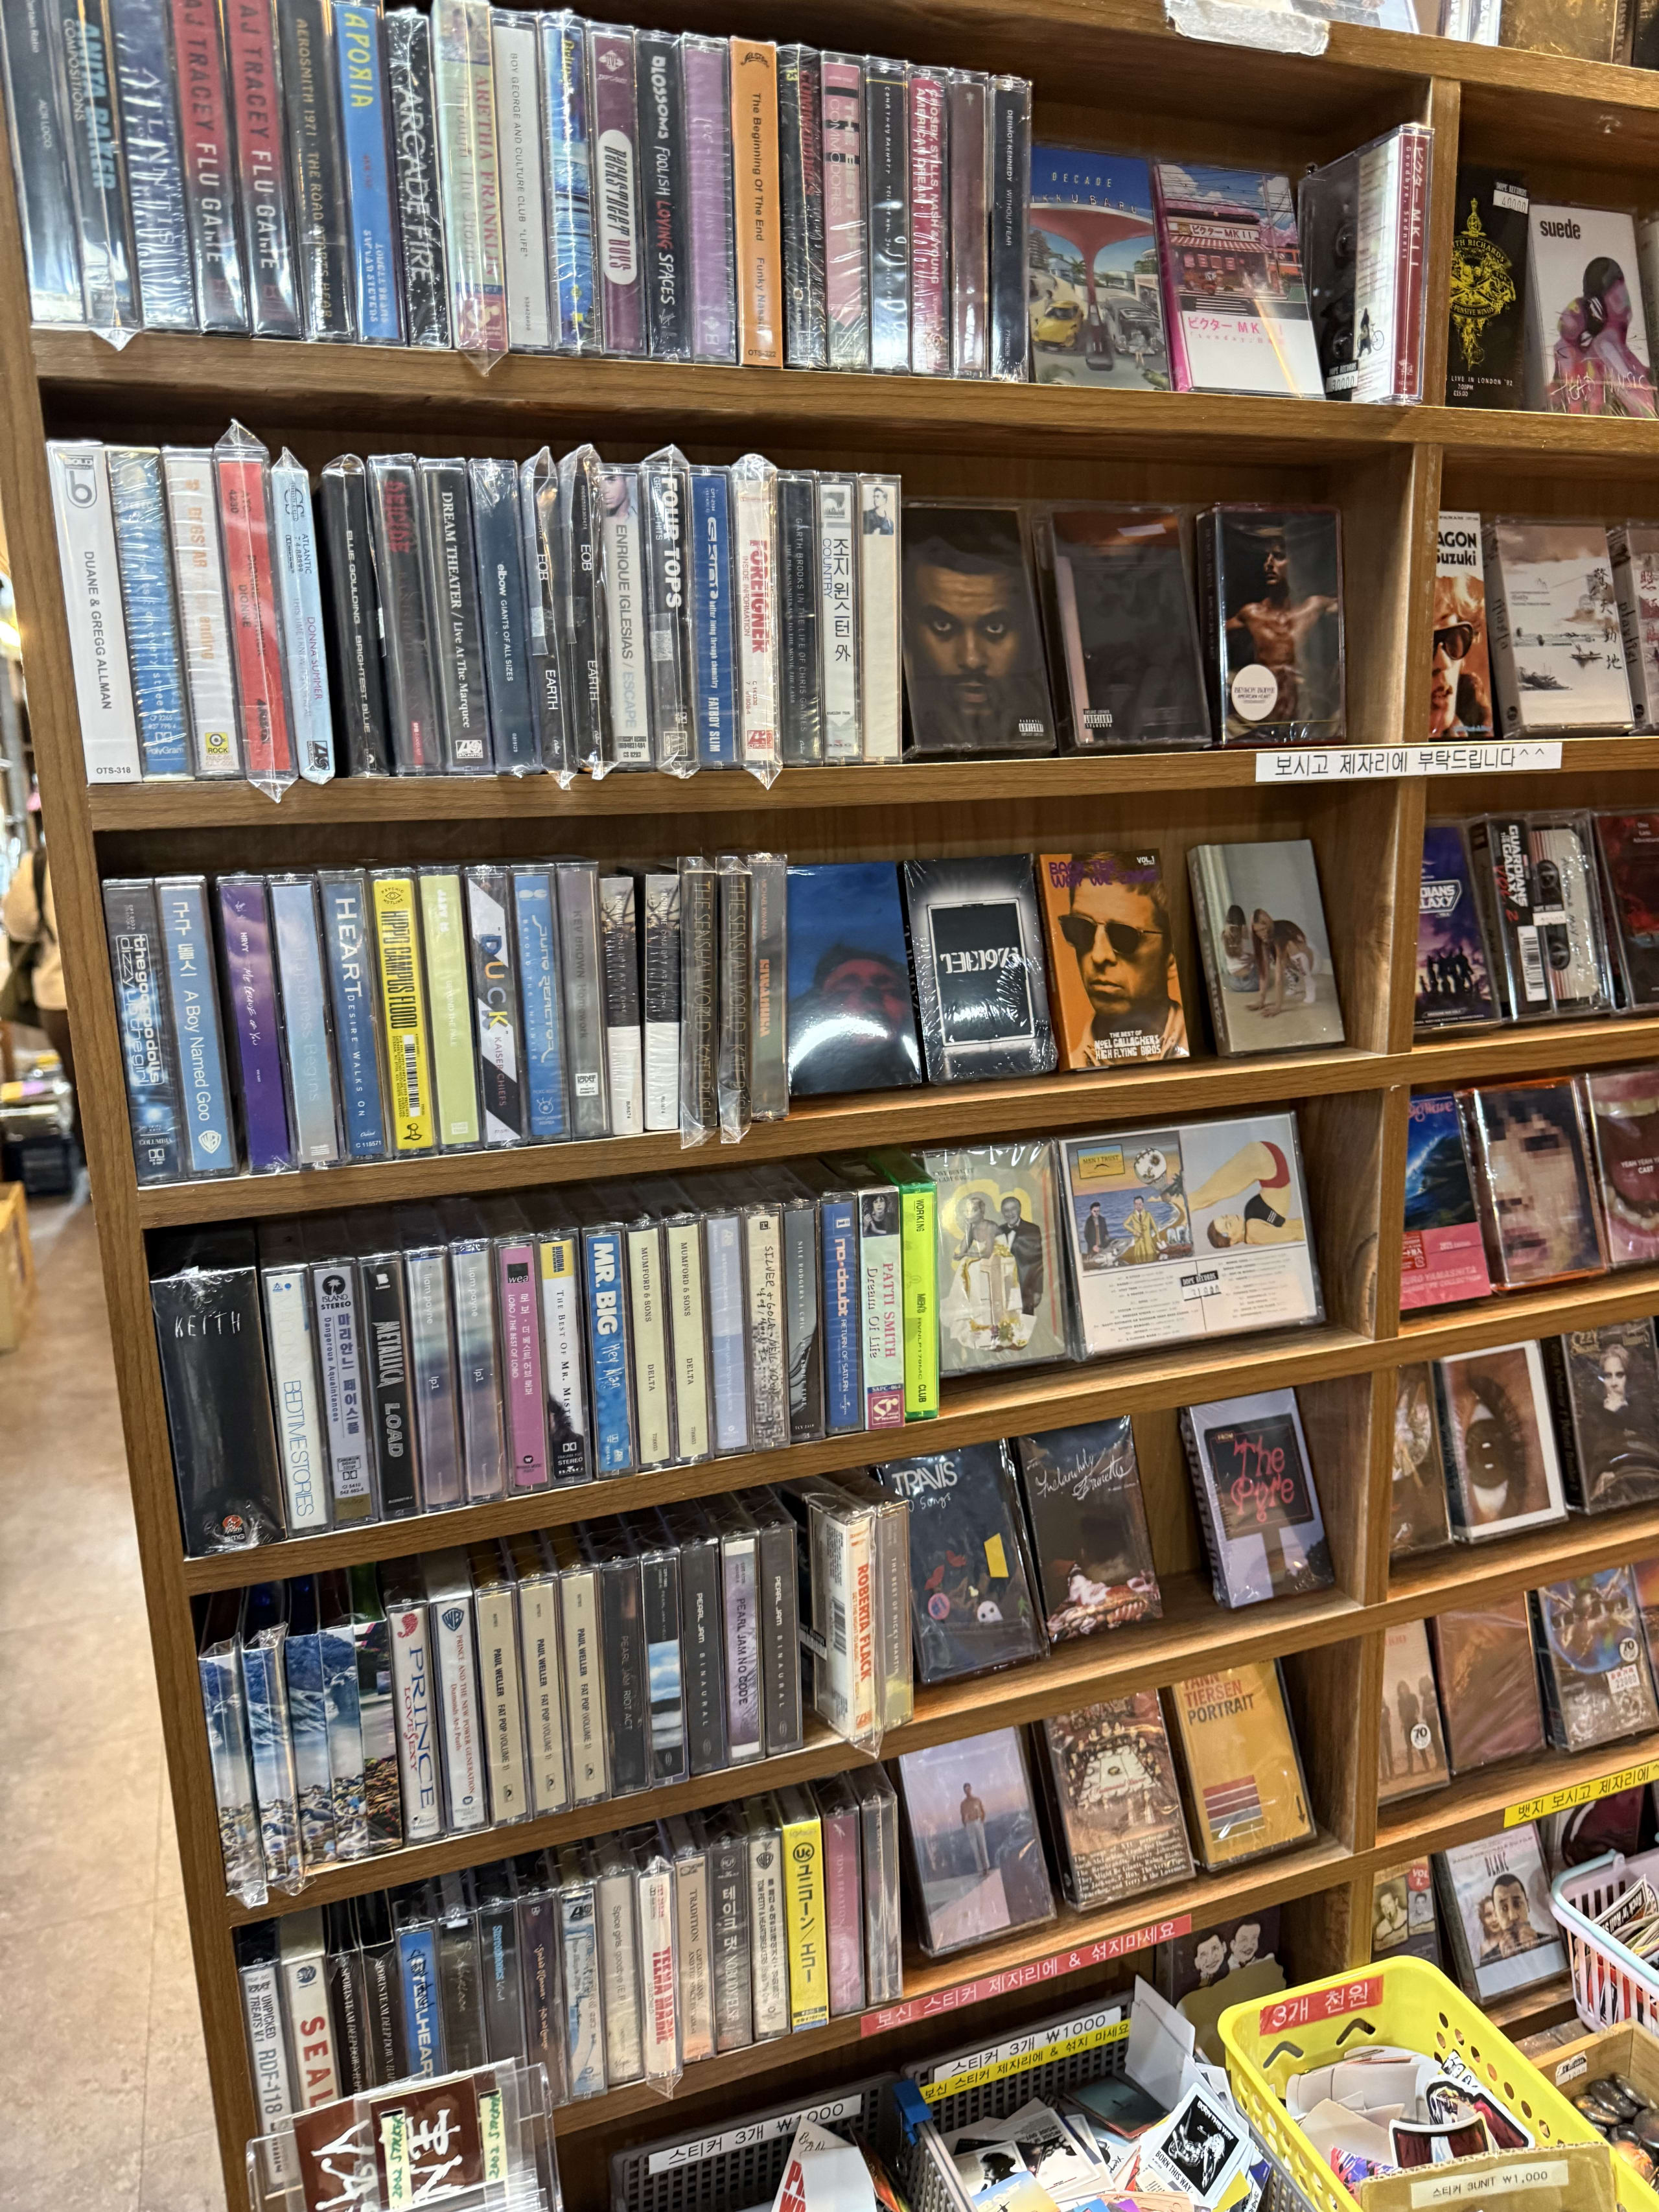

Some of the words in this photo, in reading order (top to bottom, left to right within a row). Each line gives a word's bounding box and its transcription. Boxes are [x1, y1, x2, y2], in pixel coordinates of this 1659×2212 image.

[240, 5, 261, 32] AJ
[510, 53, 518, 73] BOY
[244, 47, 271, 140] TRACEY
[511, 76, 520, 119] GEORGE
[651, 56, 669, 139] BLOSSOMS
[752, 93, 762, 113] The
[398, 87, 430, 215] ARCADE
[513, 122, 522, 144] AND
[752, 117, 762, 175] Beginning
[250, 150, 275, 194] FLU
[515, 147, 525, 192] CULTURE
[654, 146, 671, 196] FOOLISH
[754, 178, 763, 192] Of
[1051, 171, 1114, 188] DECADE
[517, 196, 527, 222] CLUB
[656, 201, 673, 249] LOVING
[754, 196, 763, 216] The
[255, 204, 279, 270] GAME
[519, 229, 528, 257] "LIFE"
[755, 219, 764, 241] End
[1540, 219, 1581, 239] suede
[405, 224, 434, 281] FIRE
[609, 239, 631, 270] BOYS
[657, 252, 675, 305] SPACES
[441, 492, 456, 541] DREAM
[661, 477, 679, 541] FOUR
[346, 531, 355, 560] ELLIE
[616, 524, 629, 590] ENRIQUE
[833, 539, 850, 576] 조지
[84, 552, 99, 595] DUANE
[446, 546, 461, 609] THEATER
[498, 564, 507, 596] elbow
[664, 547, 682, 608] TOPS
[822, 539, 833, 598] COUNTRY
[349, 564, 360, 623] GOULDING
[834, 583, 850, 638] 윈스턴
[91, 611, 106, 655] GREGG
[454, 622, 463, 643] Live
[500, 600, 509, 629] GIANTS
[619, 595, 633, 659] IGLESIAS
[307, 616, 318, 657] DONNA
[457, 647, 465, 658] At
[504, 631, 511, 643] OF
[97, 659, 111, 710] ALLMAN
[311, 660, 323, 699] SUMMER
[355, 636, 367, 699] BRIGHTEST
[458, 660, 467, 680] The
[505, 660, 513, 681] SIZES
[362, 704, 370, 733] BLUE
[458, 683, 471, 728] Marquee
[622, 671, 636, 728] ESCAPE
[708, 697, 719, 728] FATBOY
[709, 731, 720, 752] SLIM
[1275, 753, 1329, 776] 보시고
[1340, 750, 1408, 774] 제자리에
[172, 902, 192, 935] 구구
[380, 910, 410, 944] HIPPO
[178, 944, 197, 977] 돌스
[240, 933, 249, 952] HRVY
[336, 898, 362, 997] HEART
[384, 947, 415, 994] CAMPUS
[184, 990, 199, 1002] A
[389, 996, 417, 1029] FLOOD
[184, 1006, 200, 1032] Boy
[347, 995, 358, 1042] DESIRE
[191, 1037, 209, 1087] Named
[353, 1051, 363, 1092] WALKS
[196, 1091, 211, 1121] Goo
[357, 1101, 365, 1116] ON
[594, 1243, 615, 1288] MR.
[680, 1242, 689, 1285] MUMFORD
[321, 1294, 349, 1303] ISLAND
[867, 1268, 878, 1309] Dream
[883, 1263, 895, 1305] PATTI
[174, 1310, 242, 1339] KEITH
[321, 1300, 352, 1310] STEREO
[596, 1290, 618, 1335] BIG
[868, 1316, 879, 1331] Of
[338, 1313, 355, 1369] 마리안느
[371, 1321, 404, 1388] METALLICA
[596, 1343, 621, 1364] Hey
[869, 1336, 881, 1358] Life
[884, 1312, 896, 1358] SMITH
[598, 1368, 625, 1389] Man
[384, 1403, 403, 1457] LOAD
[891, 1462, 958, 1496] TRAVIS
[736, 1598, 746, 1632] PEARL
[857, 1563, 870, 1632] ROBERTA
[494, 1648, 502, 1667] PAUL
[737, 1635, 746, 1655] JAM
[859, 1635, 872, 1682] FLACK
[1622, 1640, 1634, 1651] 70
[495, 1668, 504, 1696] WELLER
[737, 1657, 747, 1673] NO
[739, 1676, 748, 1705] CODE
[1184, 1679, 1242, 1707] TIERSEN
[1187, 1695, 1254, 1725] PORTRAIT
[410, 1647, 434, 1808] PRINCE
[1413, 1727, 1427, 1738] 70
[500, 1733, 509, 1763] (VOLUME
[1518, 1801, 1543, 1819] 뱃지
[1551, 1785, 1591, 1810] 보시고
[1599, 1765, 1650, 1793] 제자리에
[876, 2005, 914, 2030] 보신
[923, 1985, 978, 2015] 스티커
[988, 1960, 1058, 1994] 제자리에
[1069, 1955, 1080, 1967] &
[1091, 1922, 1176, 1961] 섞지마세요
[249, 1996, 261, 2027] TREATS
[261, 1994, 276, 2039] UNPICKED
[1271, 2001, 1310, 2028] 3개
[1324, 1982, 1369, 2013] 천원
[300, 2015, 332, 2106] SEAL
[924, 2082, 949, 2100] 보신
[954, 2069, 990, 2092] 스티커
[997, 2053, 1043, 2078] 제자리에
[1050, 2047, 1058, 2056] &
[1065, 2038, 1089, 2053] 섞지
[1095, 2023, 1130, 2045] 마세요
[951, 2051, 999, 2075] 스티커
[1010, 2038, 1036, 2058] 3개
[1045, 2013, 1106, 2043] ₩1000
[258, 2049, 282, 2114] RDF-118
[668, 2137, 722, 2164] 스티커
[735, 2125, 763, 2145] 3개
[1155, 2150, 1169, 2165] BORN
[1168, 2165, 1179, 2180] THIS
[1179, 2176, 1192, 2193] WAY
[1432, 2182, 1461, 2198] 스티커
[1502, 2170, 1548, 2186] ₩1,000
